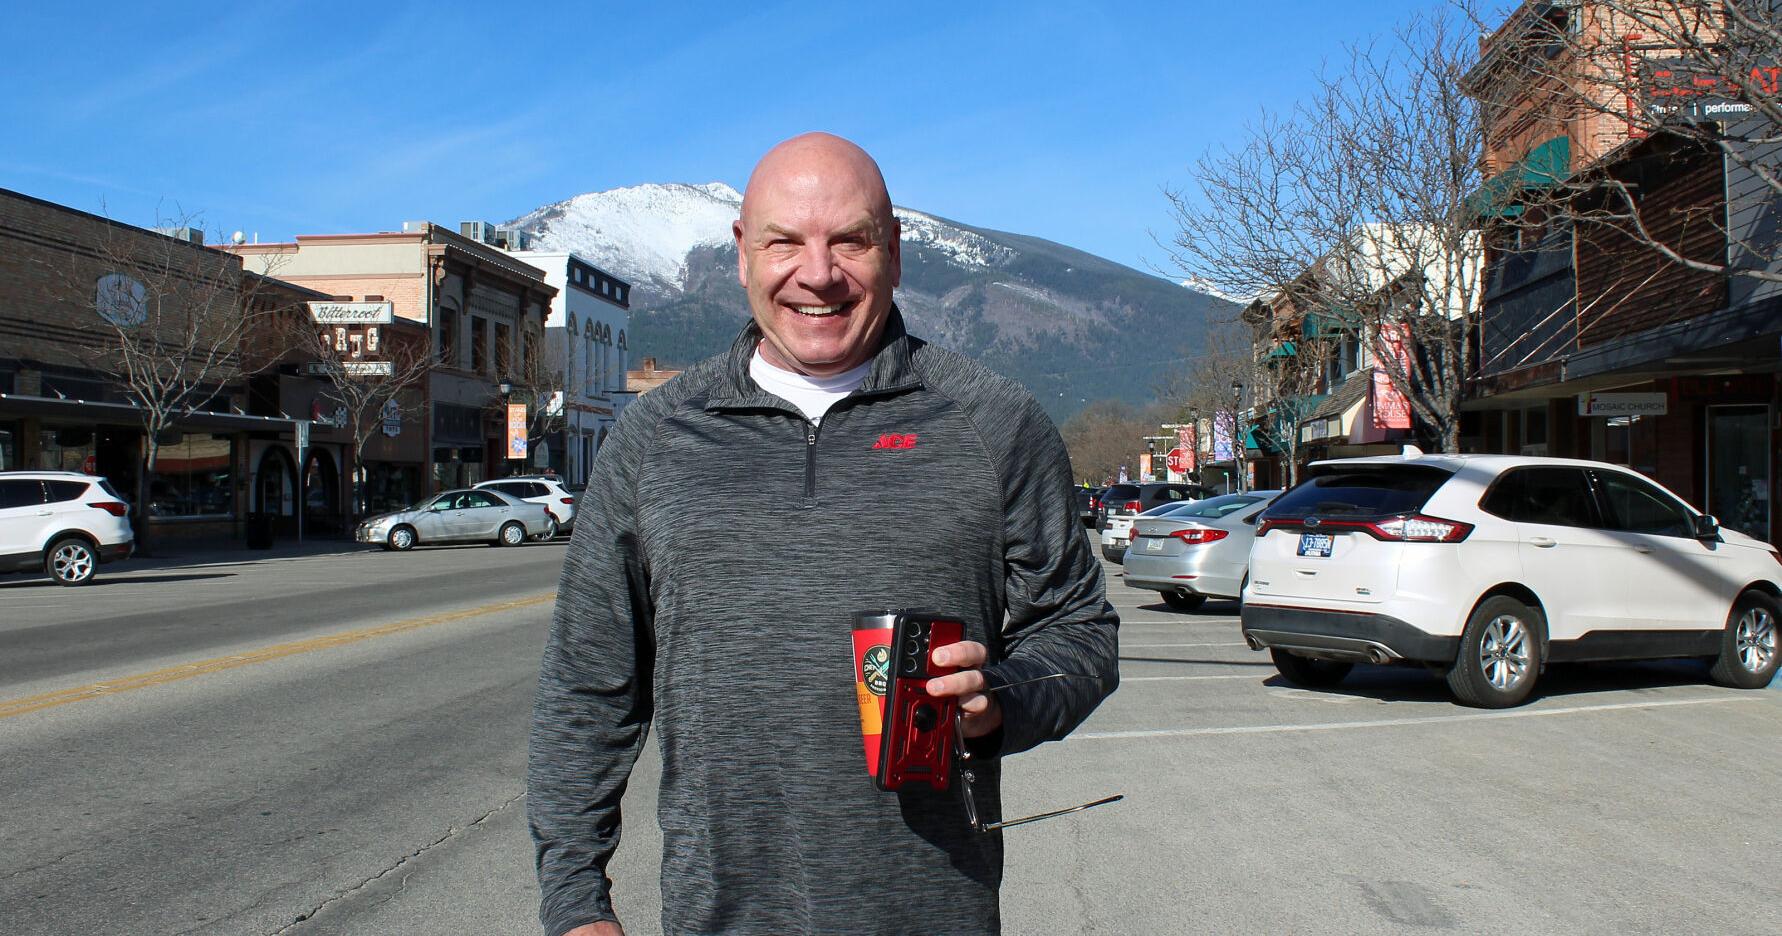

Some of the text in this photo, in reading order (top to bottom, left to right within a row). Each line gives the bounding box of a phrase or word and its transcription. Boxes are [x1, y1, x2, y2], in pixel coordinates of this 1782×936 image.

[318, 305, 384, 319] Bitterroot
[1592, 402, 1665, 411] MOSAIC CHURCH
[871, 432, 918, 449] ACE
